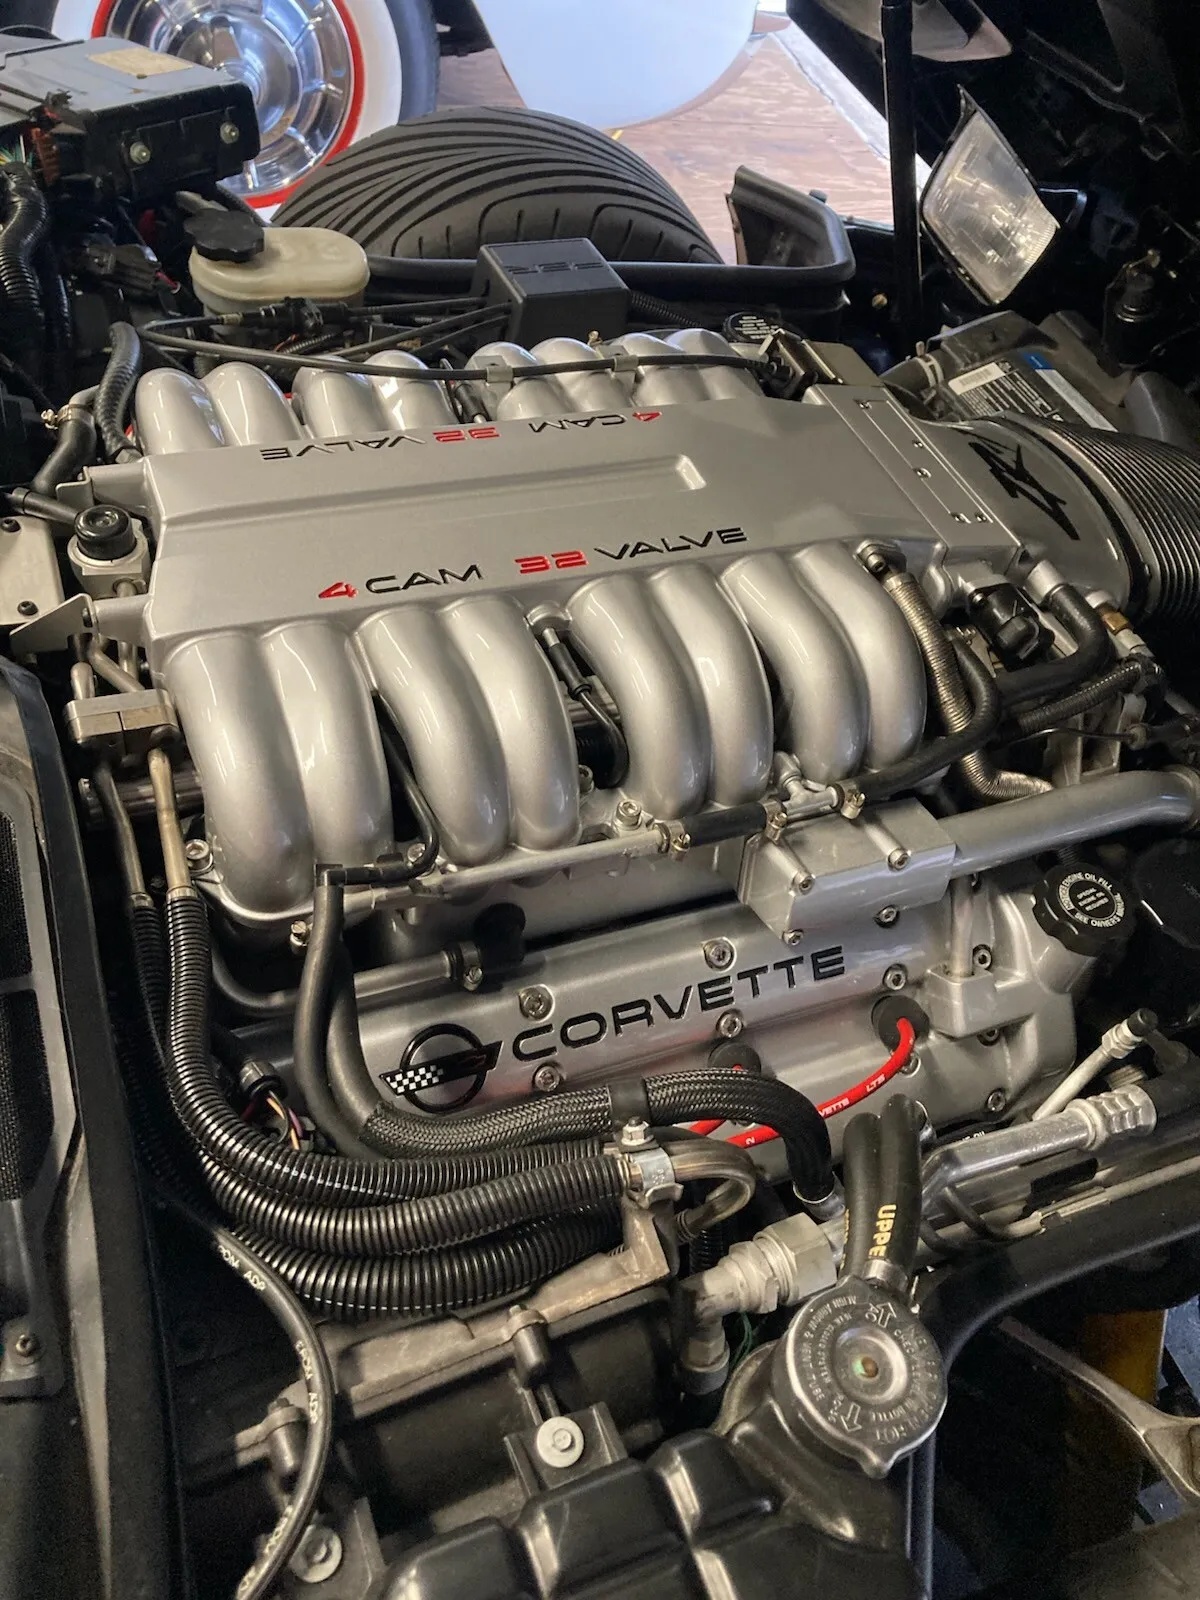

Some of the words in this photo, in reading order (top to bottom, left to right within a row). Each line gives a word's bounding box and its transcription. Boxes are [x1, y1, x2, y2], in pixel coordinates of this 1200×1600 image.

[528, 413, 628, 434] CAM
[432, 426, 500, 443] 32
[259, 434, 426, 461] VALVE
[317, 581, 359, 600] 4
[365, 564, 484, 595] CAM
[513, 550, 589, 575] 32
[594, 527, 748, 561] VALVE
[1085, 873, 1097, 882] OIL
[1098, 877, 1113, 891] FILL
[1075, 912, 1089, 924] SEE
[511, 945, 846, 1061] CORVETTE
[868, 1204, 897, 1259] UPPE
[865, 1302, 879, 1323] AC
